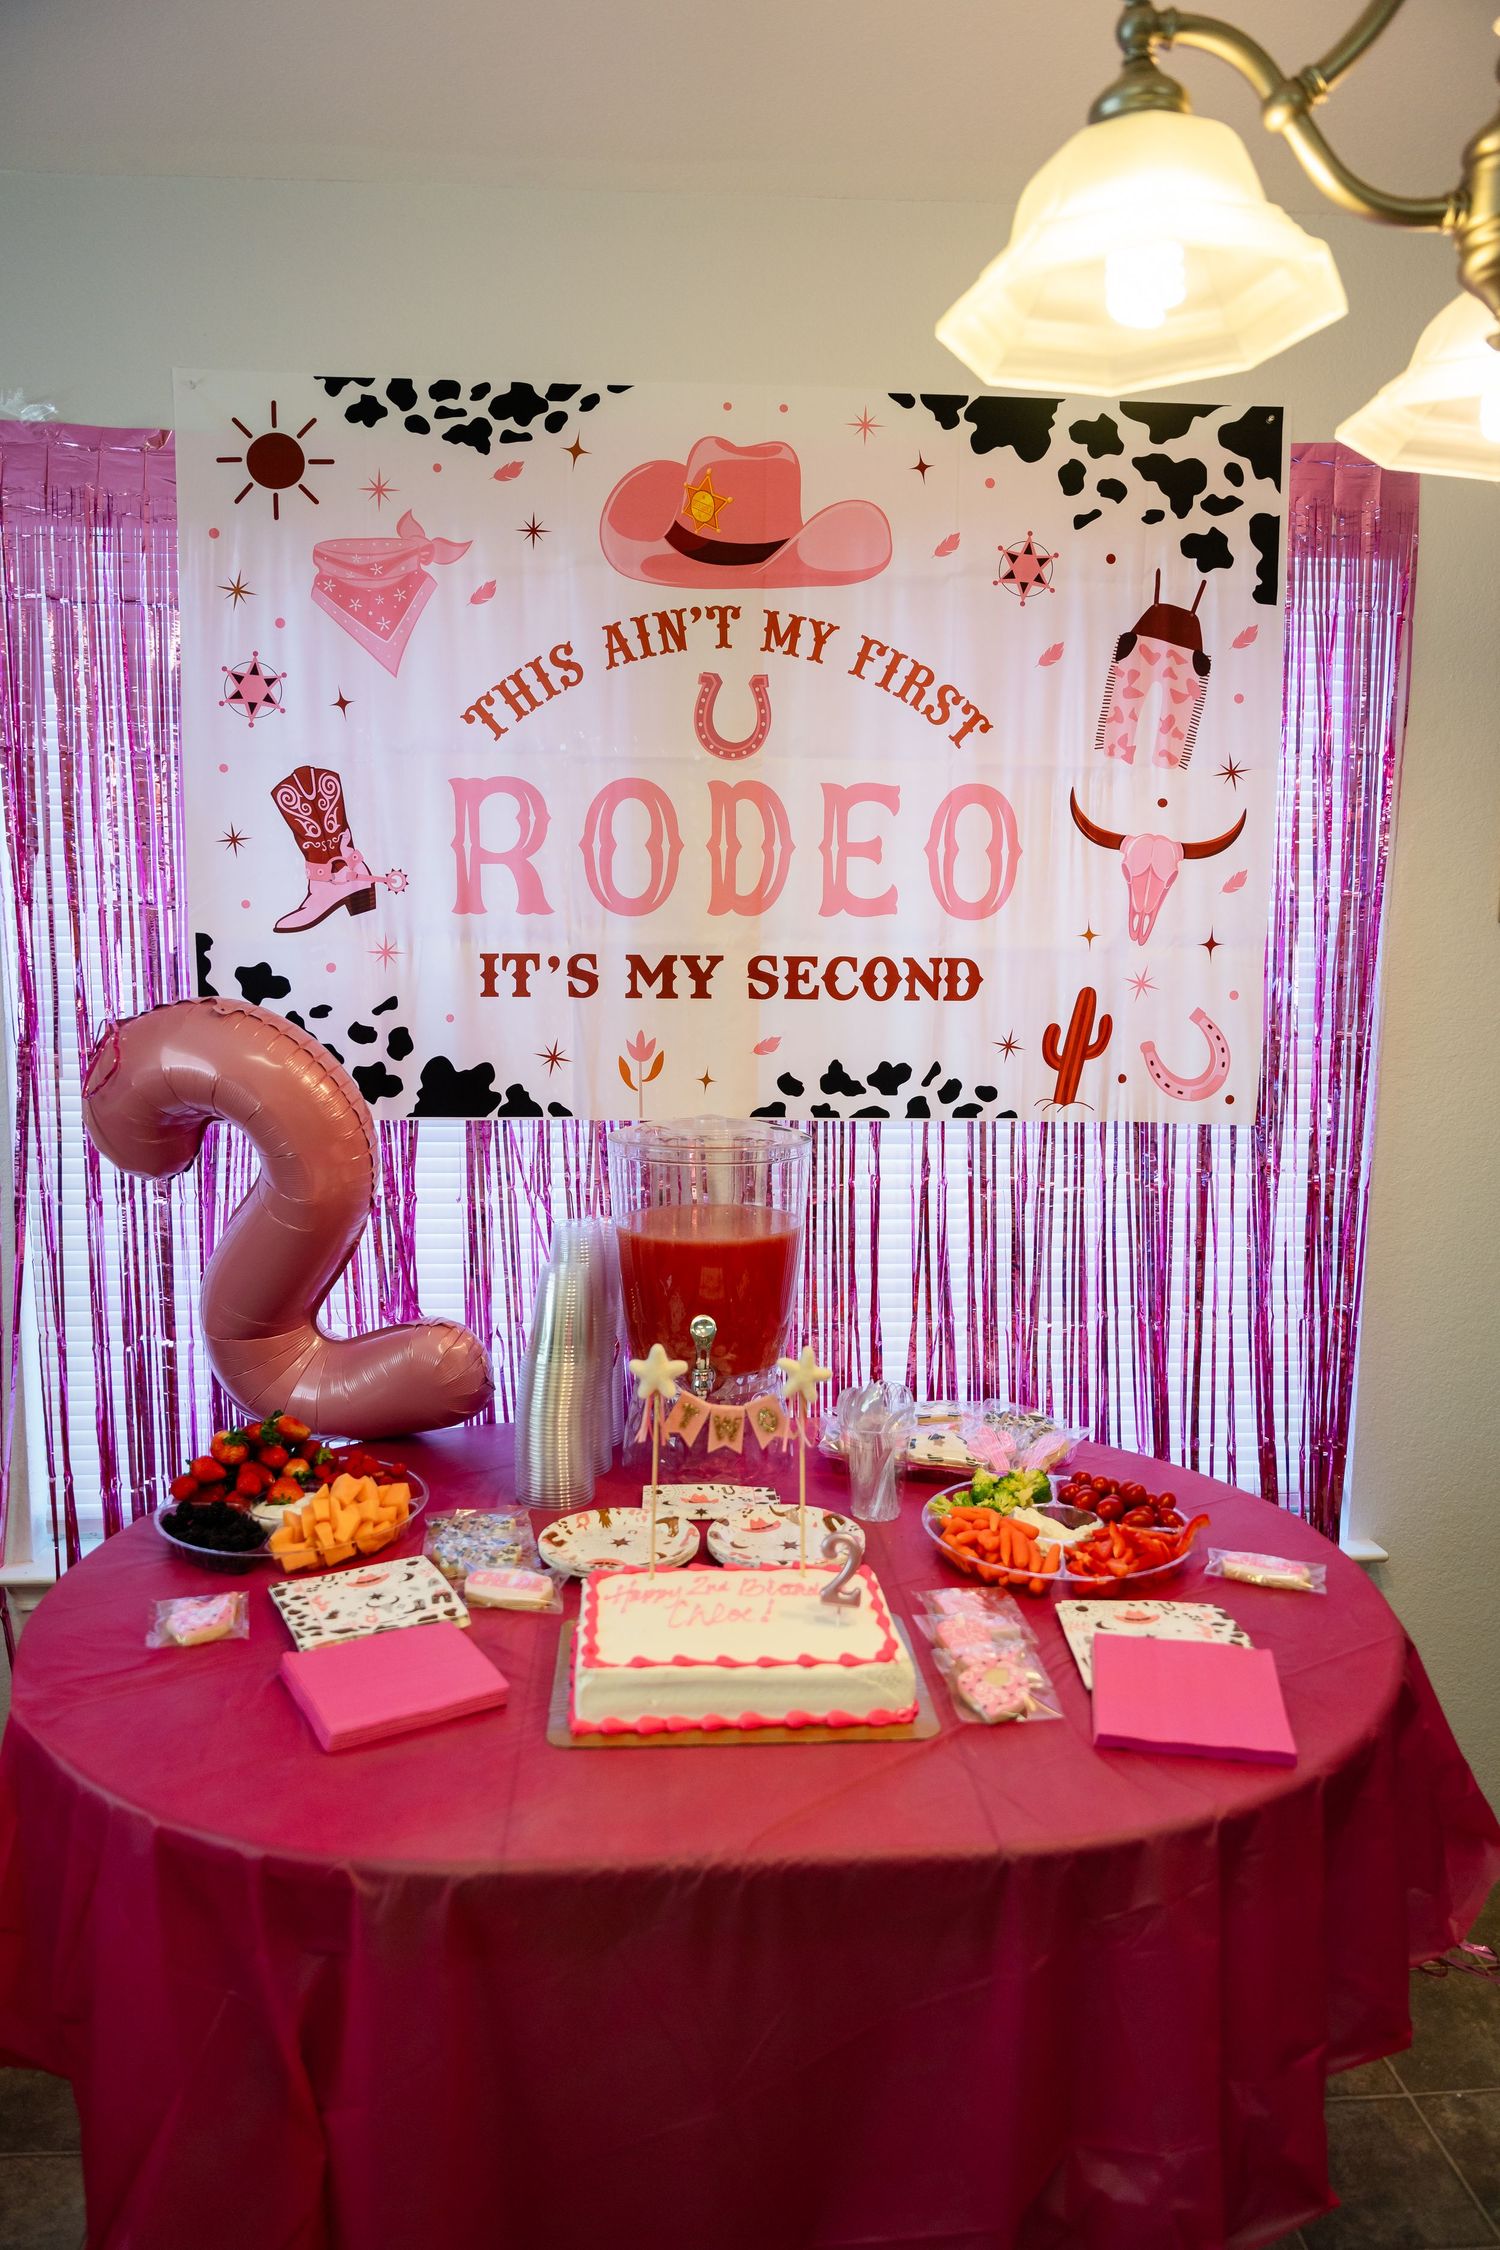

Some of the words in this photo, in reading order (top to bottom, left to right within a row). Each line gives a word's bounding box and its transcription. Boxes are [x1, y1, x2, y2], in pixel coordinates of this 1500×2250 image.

[460, 640, 585, 742] THIS
[601, 605, 742, 670] AIN'T
[760, 608, 840, 665] MY
[848, 634, 994, 750] FIRST
[447, 775, 1024, 921] RODEO
[479, 952, 600, 999] IT'S
[625, 954, 725, 1000] MY
[746, 954, 985, 1002] SECOND
[82, 996, 495, 1441] 2
[677, 1401, 780, 1443] TWO
[820, 1532, 863, 1608] 2
